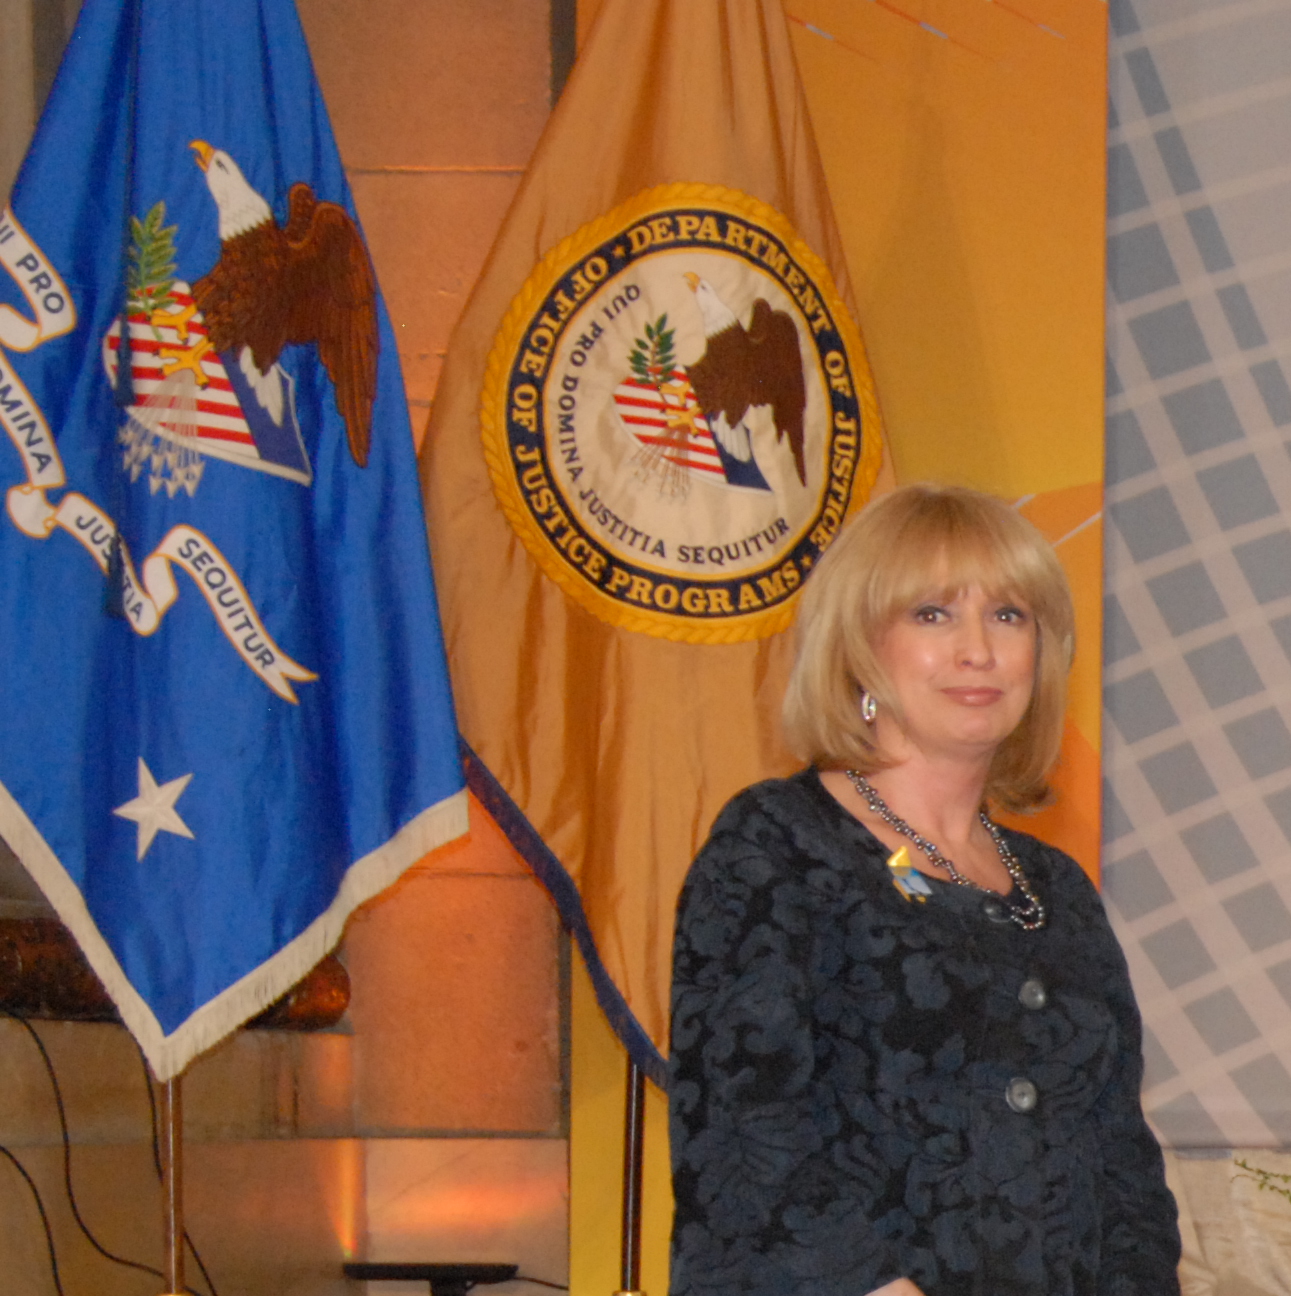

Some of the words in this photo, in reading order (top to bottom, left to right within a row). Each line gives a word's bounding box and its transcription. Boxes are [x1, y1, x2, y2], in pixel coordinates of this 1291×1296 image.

[16, 252, 65, 314] PRO
[603, 283, 641, 321] QUI
[627, 214, 832, 334] DEPARTMENT
[520, 258, 609, 378] OFFICE
[569, 321, 604, 368] PRO
[513, 383, 539, 432] OF
[824, 350, 853, 398] OF
[0, 368, 53, 474] MINA
[558, 376, 584, 483] DOMINA
[515, 444, 612, 579] JUSTICE
[809, 411, 857, 552] JUSTICE
[579, 489, 667, 559] JUSTITIA
[677, 517, 791, 566] SEQUITUR
[177, 538, 275, 669] SEQUITUR
[609, 560, 802, 614] PROGRAMS
